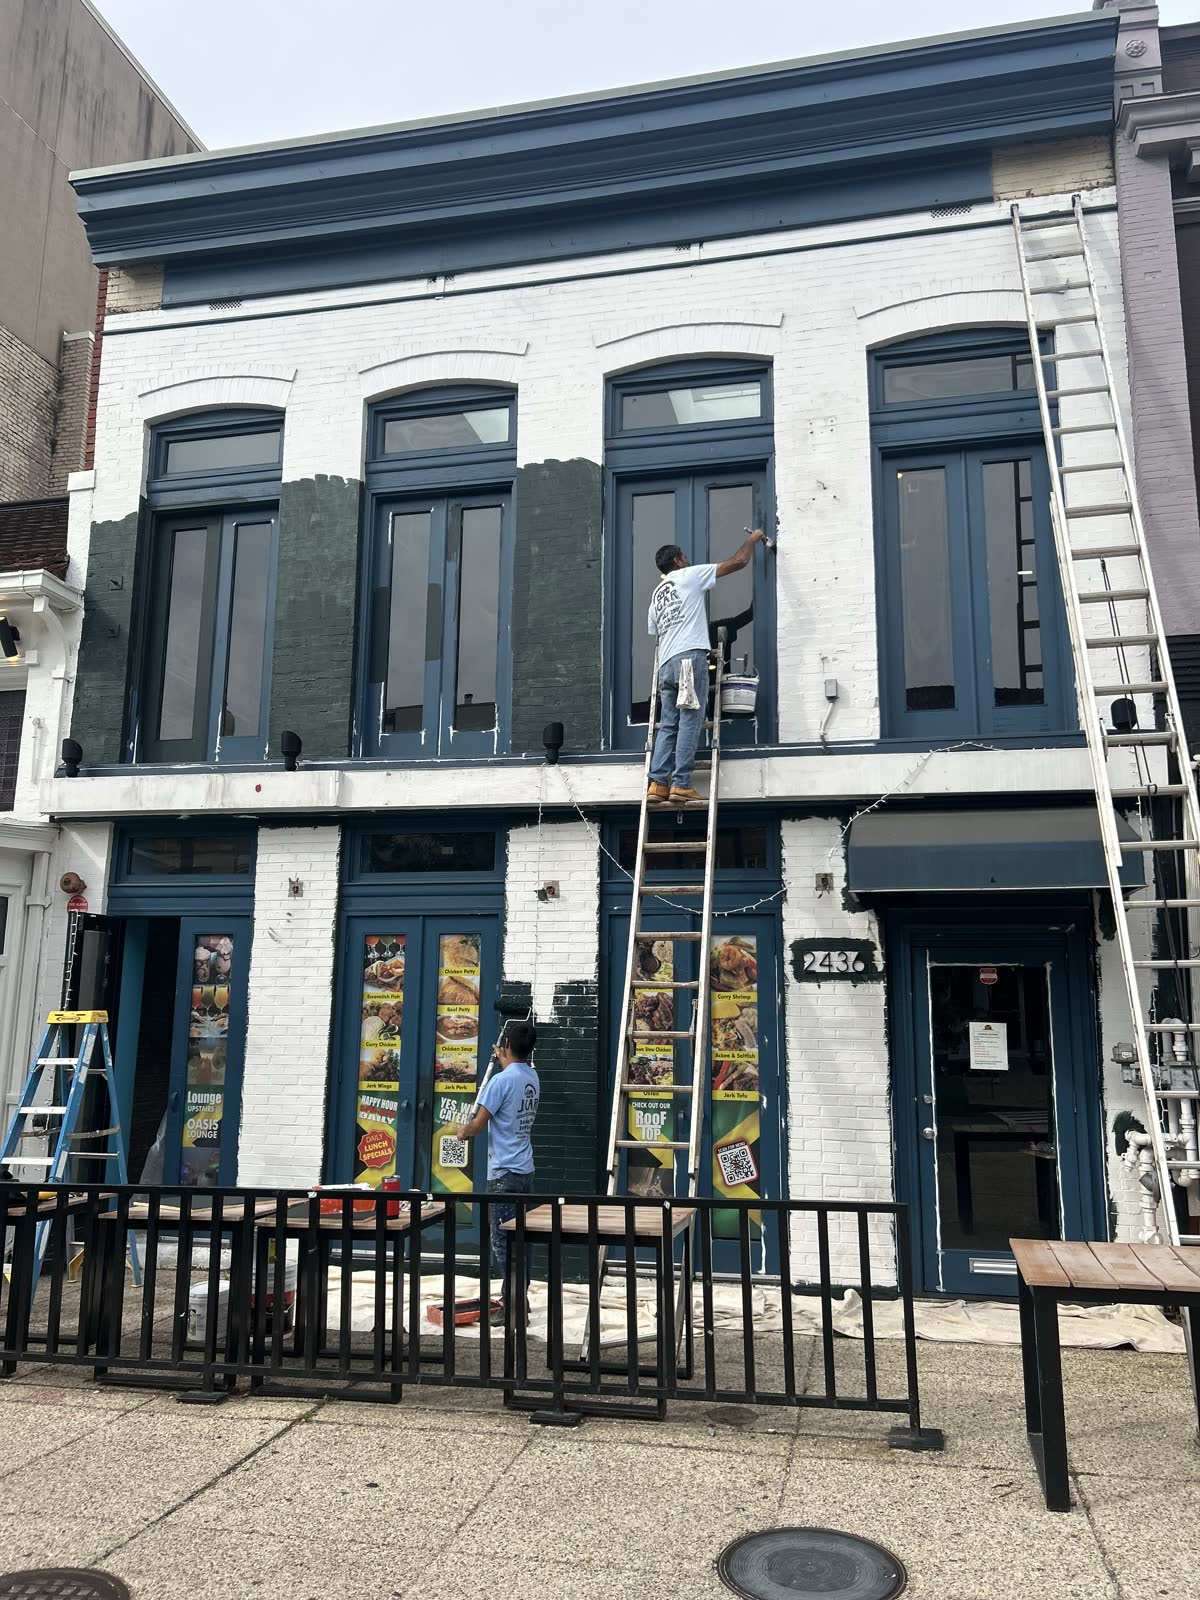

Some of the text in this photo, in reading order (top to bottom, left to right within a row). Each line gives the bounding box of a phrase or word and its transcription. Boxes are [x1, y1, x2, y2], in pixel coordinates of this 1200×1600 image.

[803, 951, 865, 973] 2436
[187, 1091, 222, 1105] Lounge
[361, 1094, 381, 1108] HAPPY
[381, 1098, 398, 1112] HOUR
[187, 1118, 219, 1130] OASIS
[359, 1111, 395, 1125] DAILY
[187, 1130, 218, 1138] LOUNGE
[366, 1133, 383, 1144] DAILY
[636, 1125, 662, 1141] TOP
[364, 1140, 388, 1152] LUNCH
[362, 1147, 393, 1161] SPECIALS
